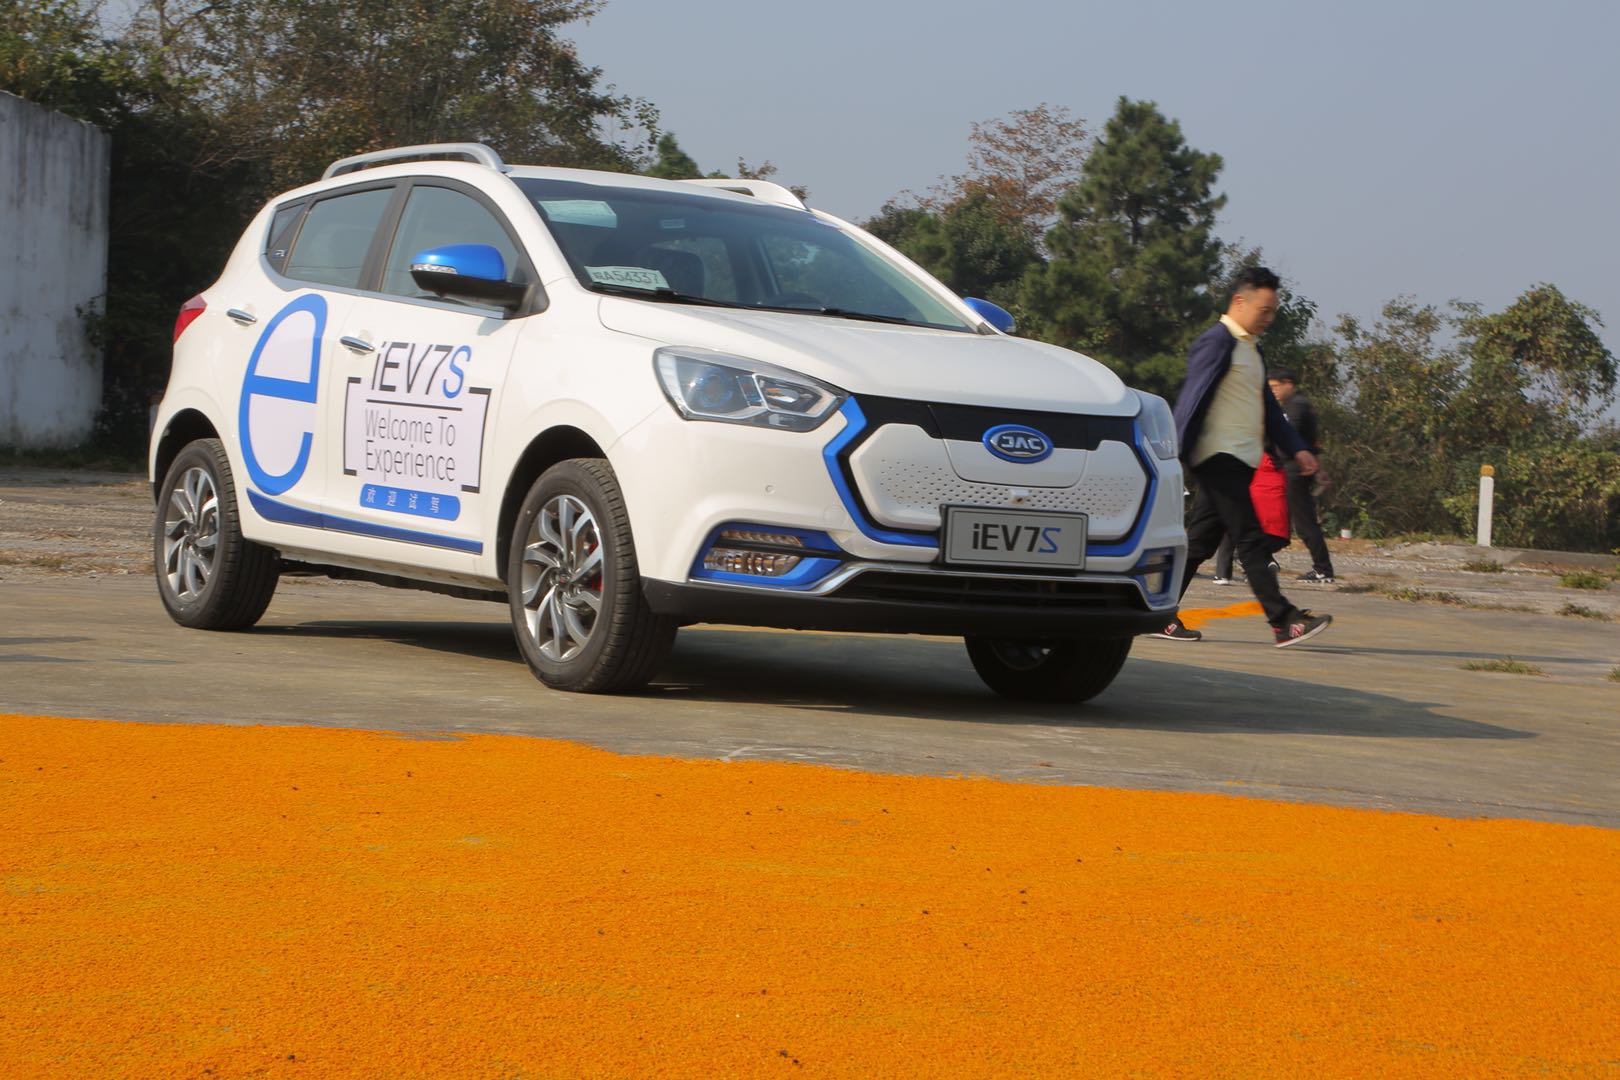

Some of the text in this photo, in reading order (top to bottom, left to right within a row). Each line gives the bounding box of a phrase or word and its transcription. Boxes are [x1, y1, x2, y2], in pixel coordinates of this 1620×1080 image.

[371, 341, 472, 399] iEV7S
[365, 409, 456, 446] Welcome To
[1001, 435, 1041, 450] JAC
[366, 440, 455, 482] Experience
[971, 523, 1062, 553] iEV7S
